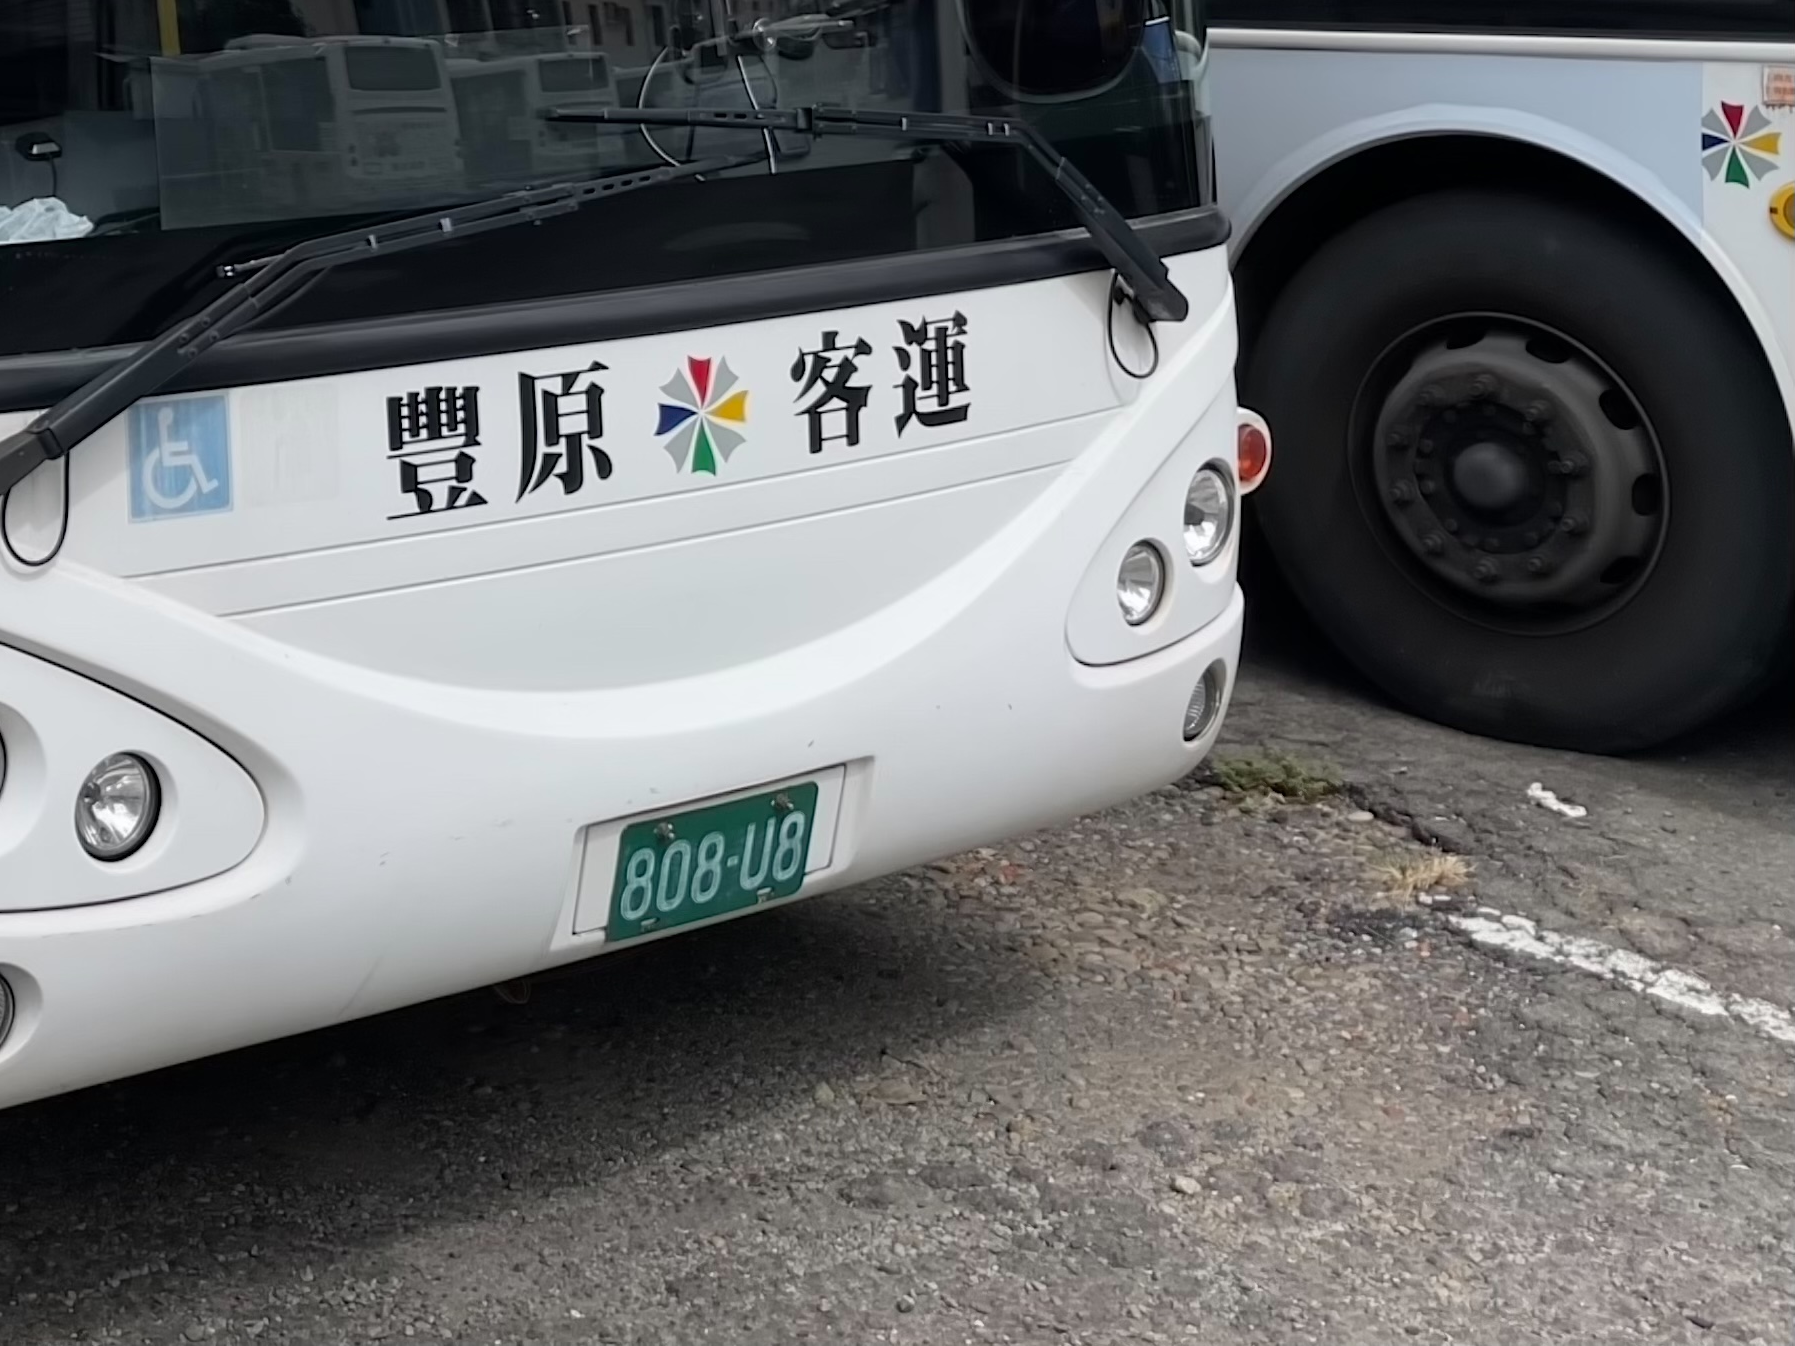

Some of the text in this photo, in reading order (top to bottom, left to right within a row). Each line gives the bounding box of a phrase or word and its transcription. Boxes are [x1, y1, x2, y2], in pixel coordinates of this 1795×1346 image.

[385, 309, 972, 522] 豐原 客運
[620, 810, 806, 921] 808-U8
